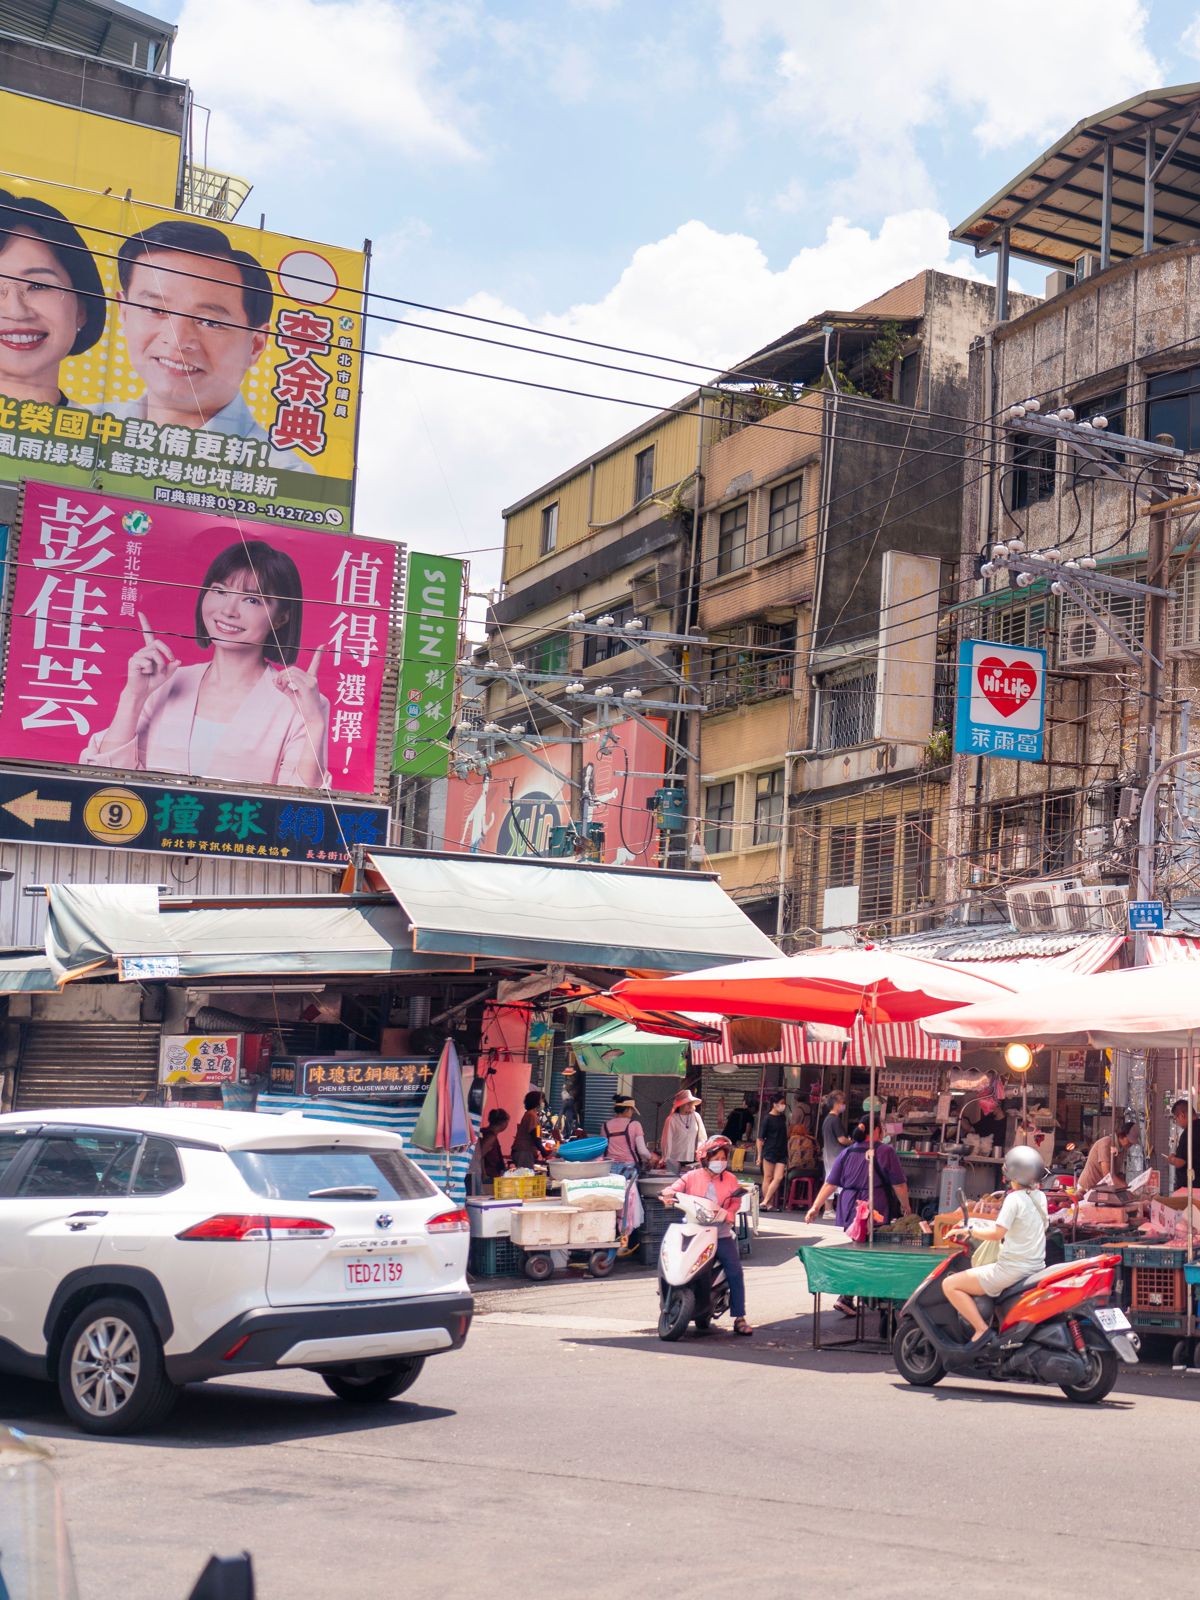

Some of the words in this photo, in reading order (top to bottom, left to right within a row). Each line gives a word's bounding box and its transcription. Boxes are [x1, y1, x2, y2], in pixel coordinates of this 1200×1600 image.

[271, 312, 330, 454] 李余典
[335, 336, 352, 418] 新北市議員
[109, 450, 278, 497] 籃球場地坪翻新
[119, 540, 142, 618] 新北市議員
[18, 496, 117, 738] 彭佳芸
[970, 726, 1038, 754] 萊爾富
[352, 1084, 388, 1092] CAUSEWAY
[347, 1263, 403, 1283] TED-2139
